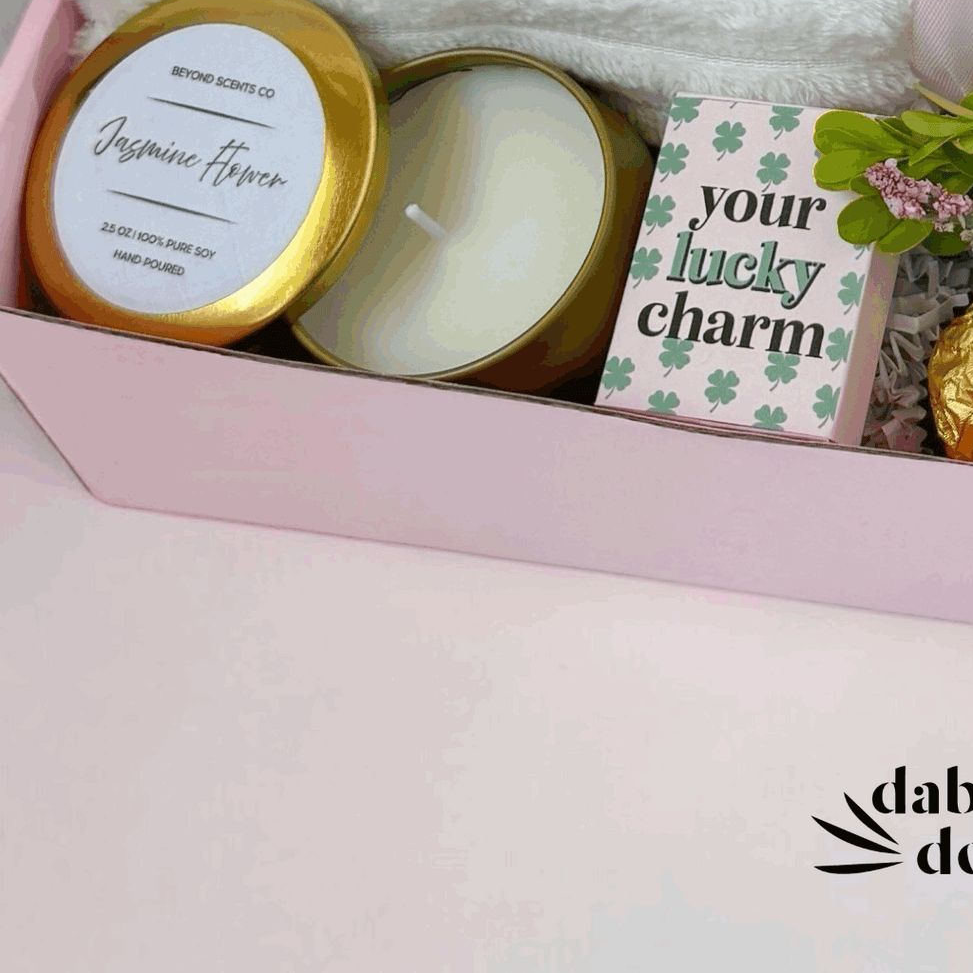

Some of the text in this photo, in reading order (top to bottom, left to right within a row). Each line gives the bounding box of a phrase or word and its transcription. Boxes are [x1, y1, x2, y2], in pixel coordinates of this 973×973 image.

[171, 65, 275, 99] BEYOND SCENTS CO
[94, 115, 288, 188] Jasmine Flower
[688, 184, 827, 231] your
[113, 249, 185, 276] HAND POURED
[118, 226, 133, 238] OZ
[137, 231, 165, 247] 100%
[165, 238, 194, 254] PURE
[194, 246, 216, 260] SOY
[666, 231, 826, 310] lucky
[637, 290, 825, 359] charm
